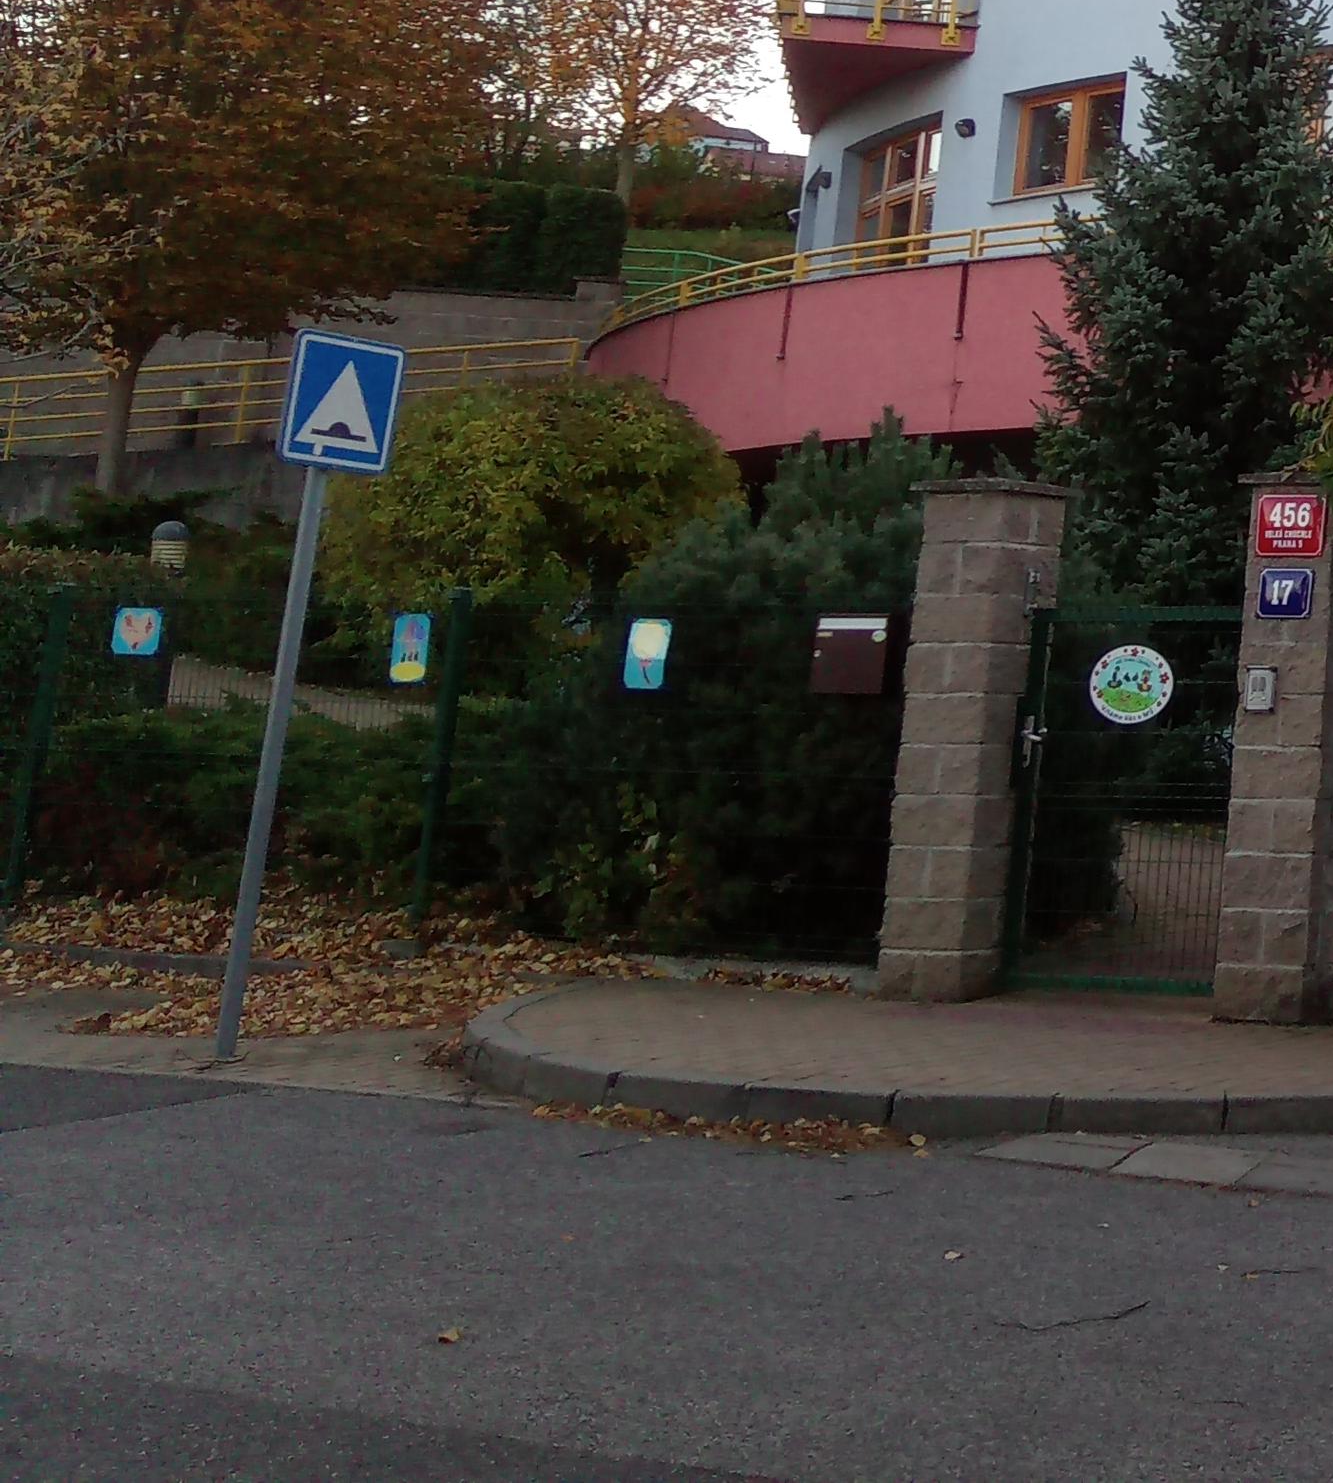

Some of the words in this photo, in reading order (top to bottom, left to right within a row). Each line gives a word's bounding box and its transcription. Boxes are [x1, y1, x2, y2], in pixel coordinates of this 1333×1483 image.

[1269, 502, 1311, 528] 456
[1273, 539, 1297, 548] PRAHA
[1271, 579, 1294, 606] 17
